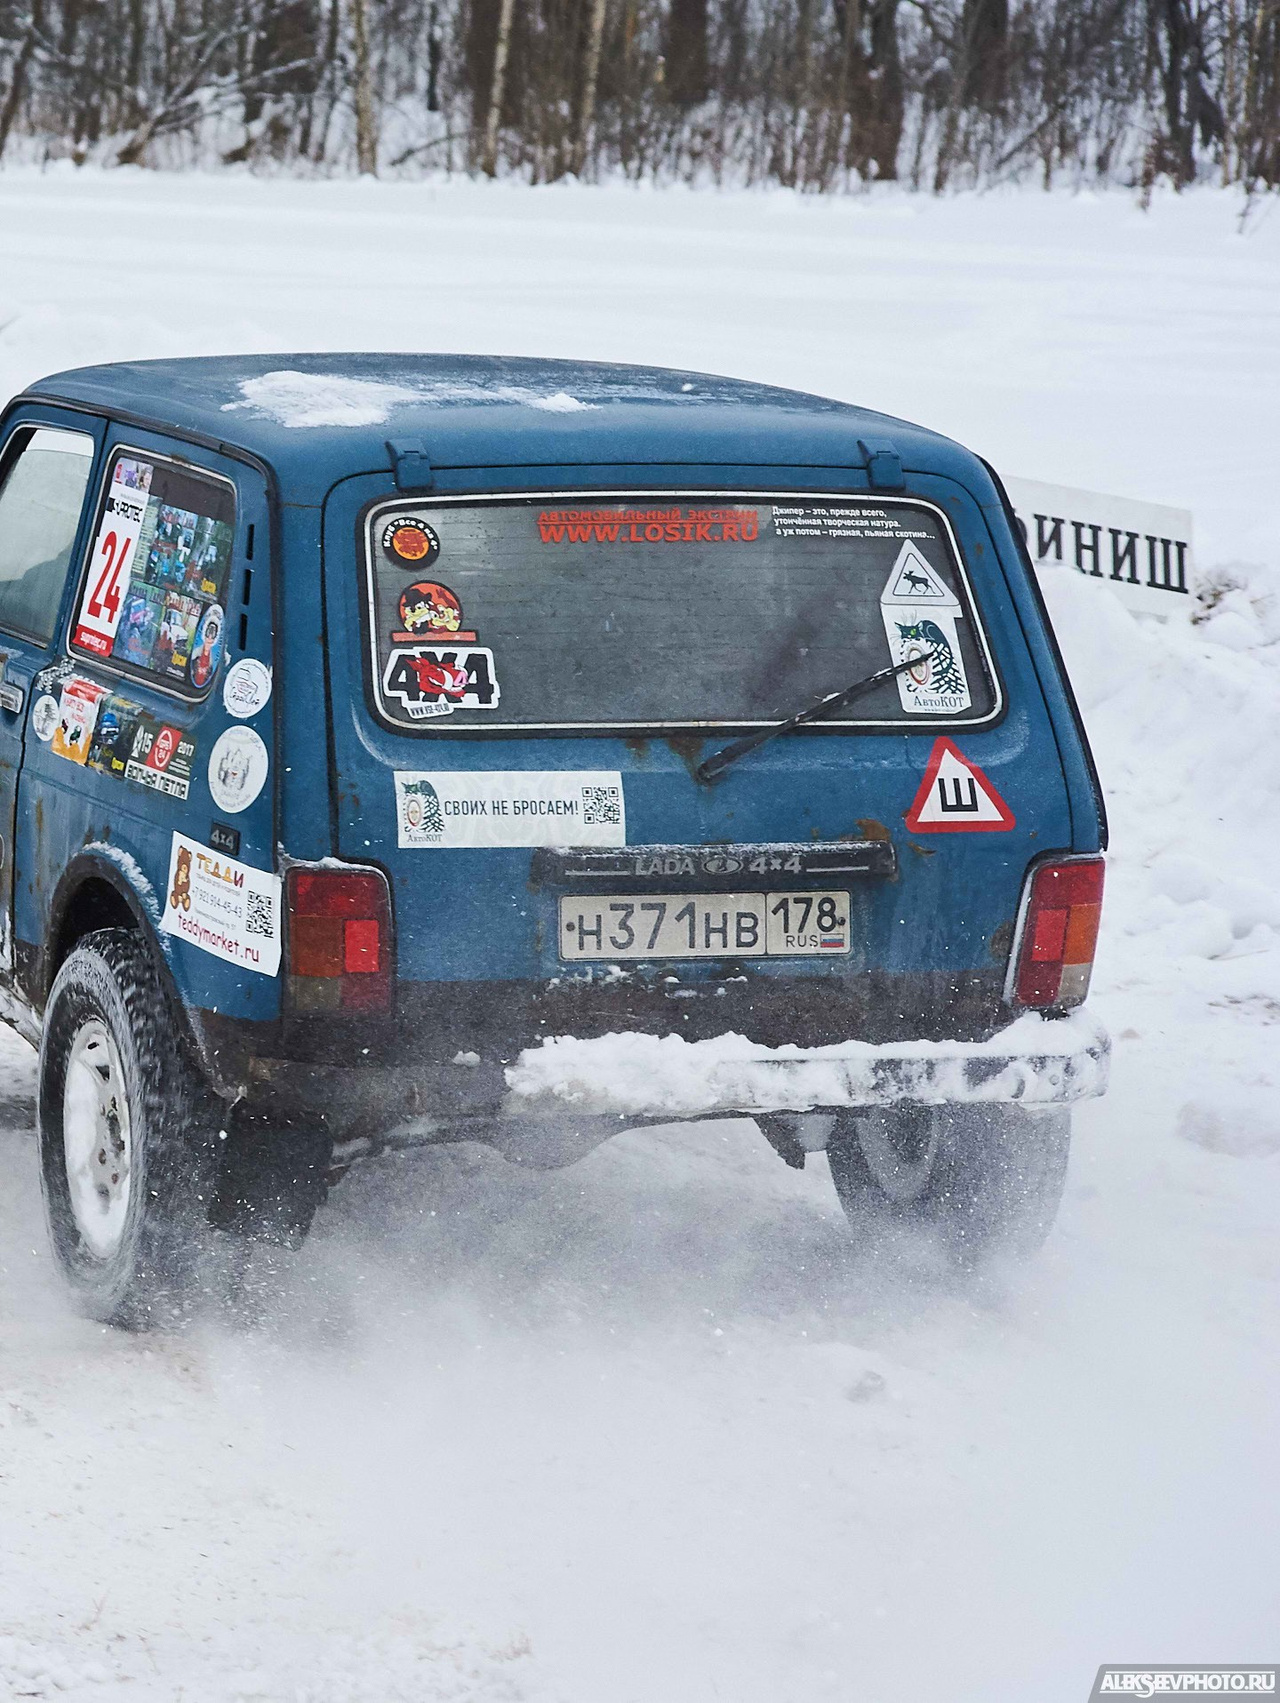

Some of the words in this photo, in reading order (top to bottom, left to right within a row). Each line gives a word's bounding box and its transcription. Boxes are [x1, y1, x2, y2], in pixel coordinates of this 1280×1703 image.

[538, 508, 682, 522] АВТОМОБИЛЬНЫЙ
[687, 509, 758, 522] ЭКСТРИМ
[772, 506, 805, 516] Джипер
[830, 509, 861, 518] прежде
[862, 510, 887, 518] всего,
[774, 517, 822, 527] утончённая
[823, 519, 870, 528] творческая
[871, 520, 901, 528] натура.
[538, 523, 759, 543] WWW.LOSIK.RU
[783, 528, 795, 537] уж
[829, 529, 863, 538] грязная,
[1014, 508, 1189, 594] ИНИШ
[87, 530, 132, 624] 24
[177, 741, 195, 757] 2017
[938, 776, 980, 813] Ш
[444, 800, 488, 816] СВОИХ
[493, 800, 509, 816] НЕ
[514, 800, 579, 816] БРОСАЕМ!
[197, 853, 244, 888] ТЕДДИ
[635, 857, 696, 875] LADA
[771, 897, 838, 934] 178
[178, 912, 260, 963] teddymarket.ru
[785, 934, 818, 948] RUS
